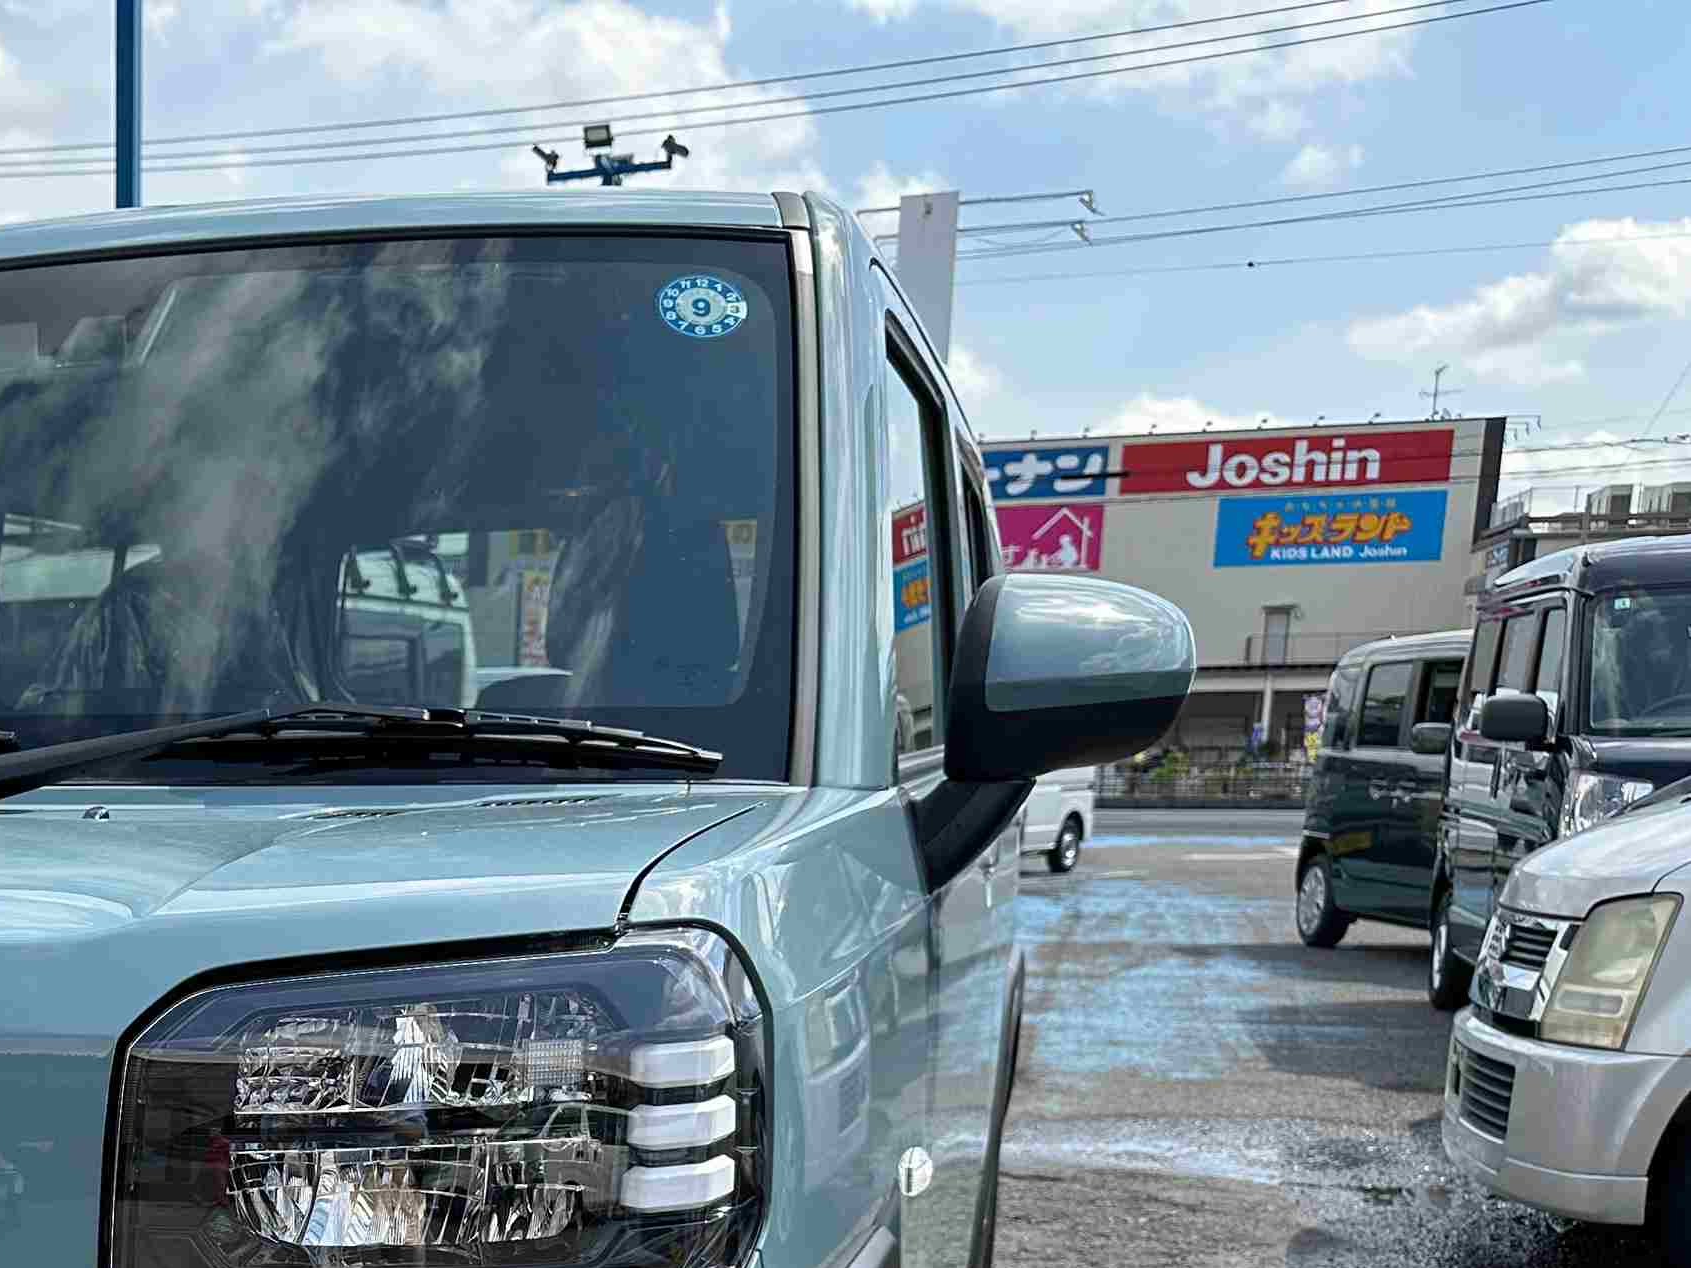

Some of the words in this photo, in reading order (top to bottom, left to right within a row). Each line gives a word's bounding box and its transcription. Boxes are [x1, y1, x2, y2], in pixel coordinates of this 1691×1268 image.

[1186, 437, 1381, 488] Joshin
[1270, 546, 1307, 560] KIDS
[1311, 546, 1354, 559] LAND
